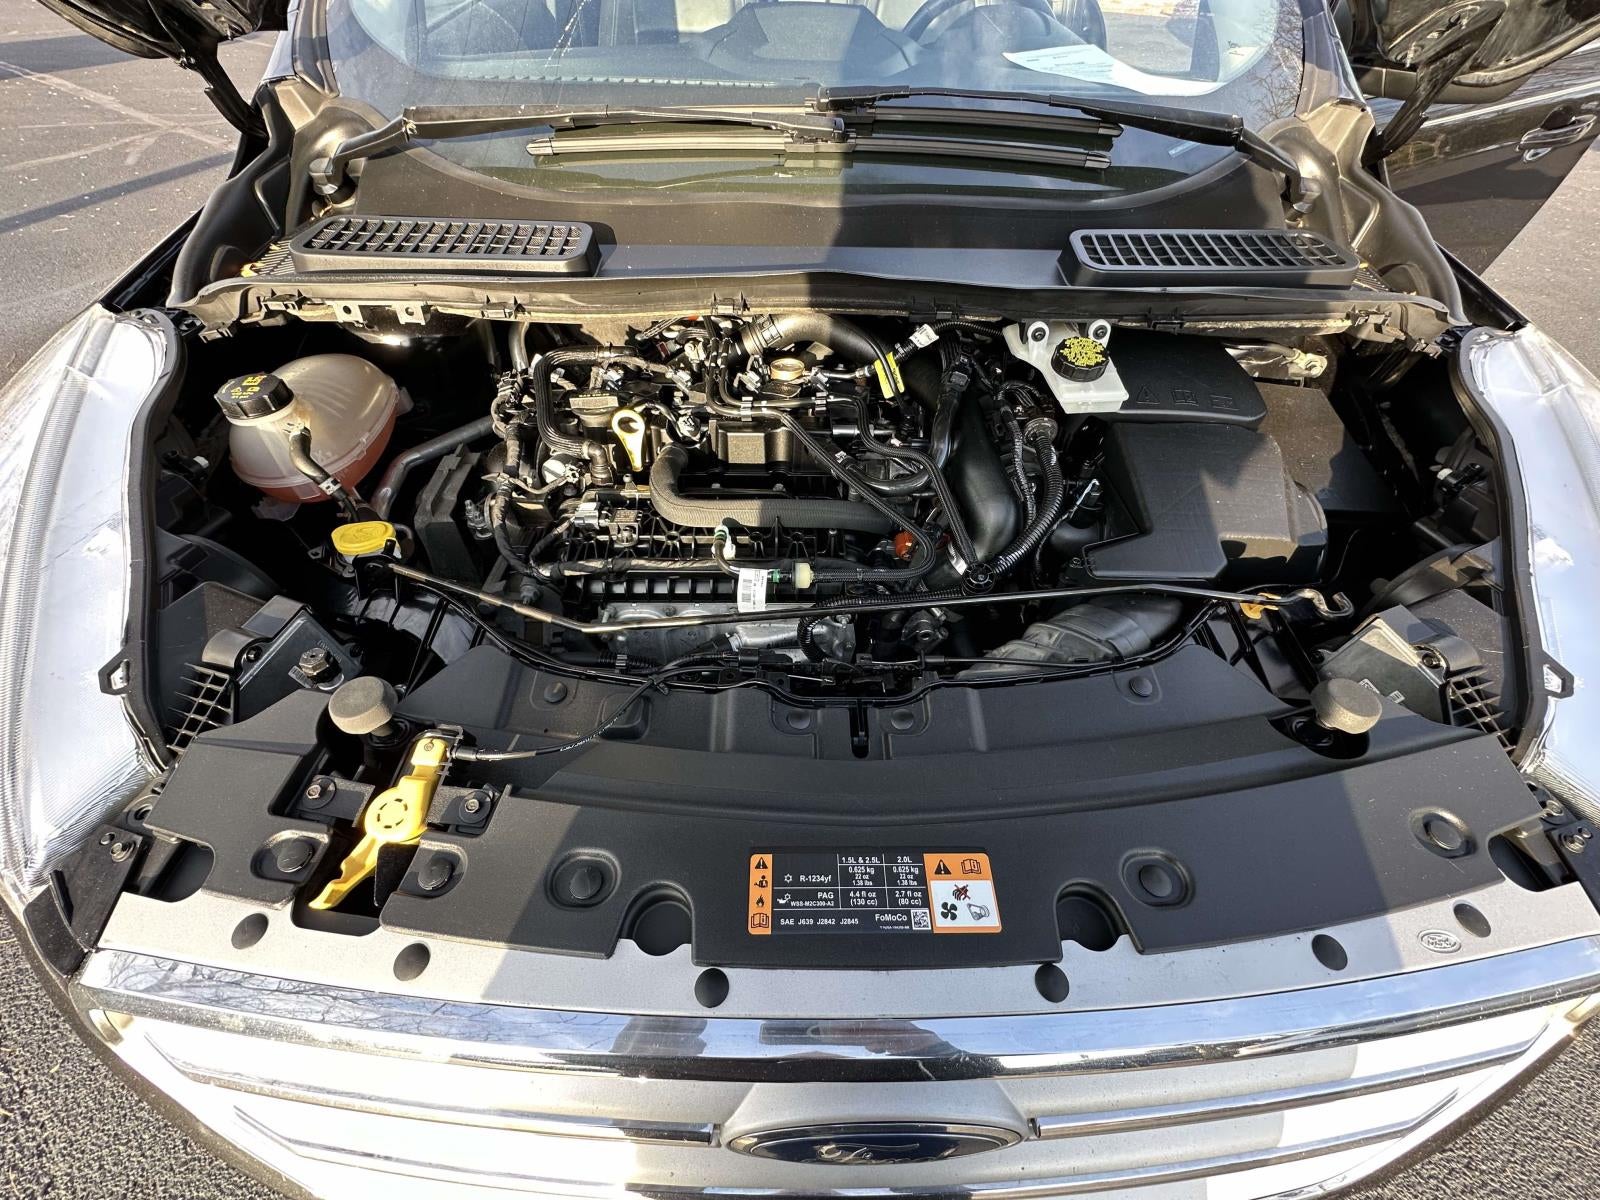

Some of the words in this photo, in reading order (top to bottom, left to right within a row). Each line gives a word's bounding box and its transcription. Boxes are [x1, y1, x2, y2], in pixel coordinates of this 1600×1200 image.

[841, 856, 857, 864] 1.5L
[858, 856, 864, 864] &
[865, 856, 880, 864] 2.5L
[866, 866, 875, 874] kg
[910, 866, 919, 874] kg
[799, 874, 832, 884] R-1234yf
[817, 891, 834, 899] PAG
[875, 914, 908, 922] FoMoCo
